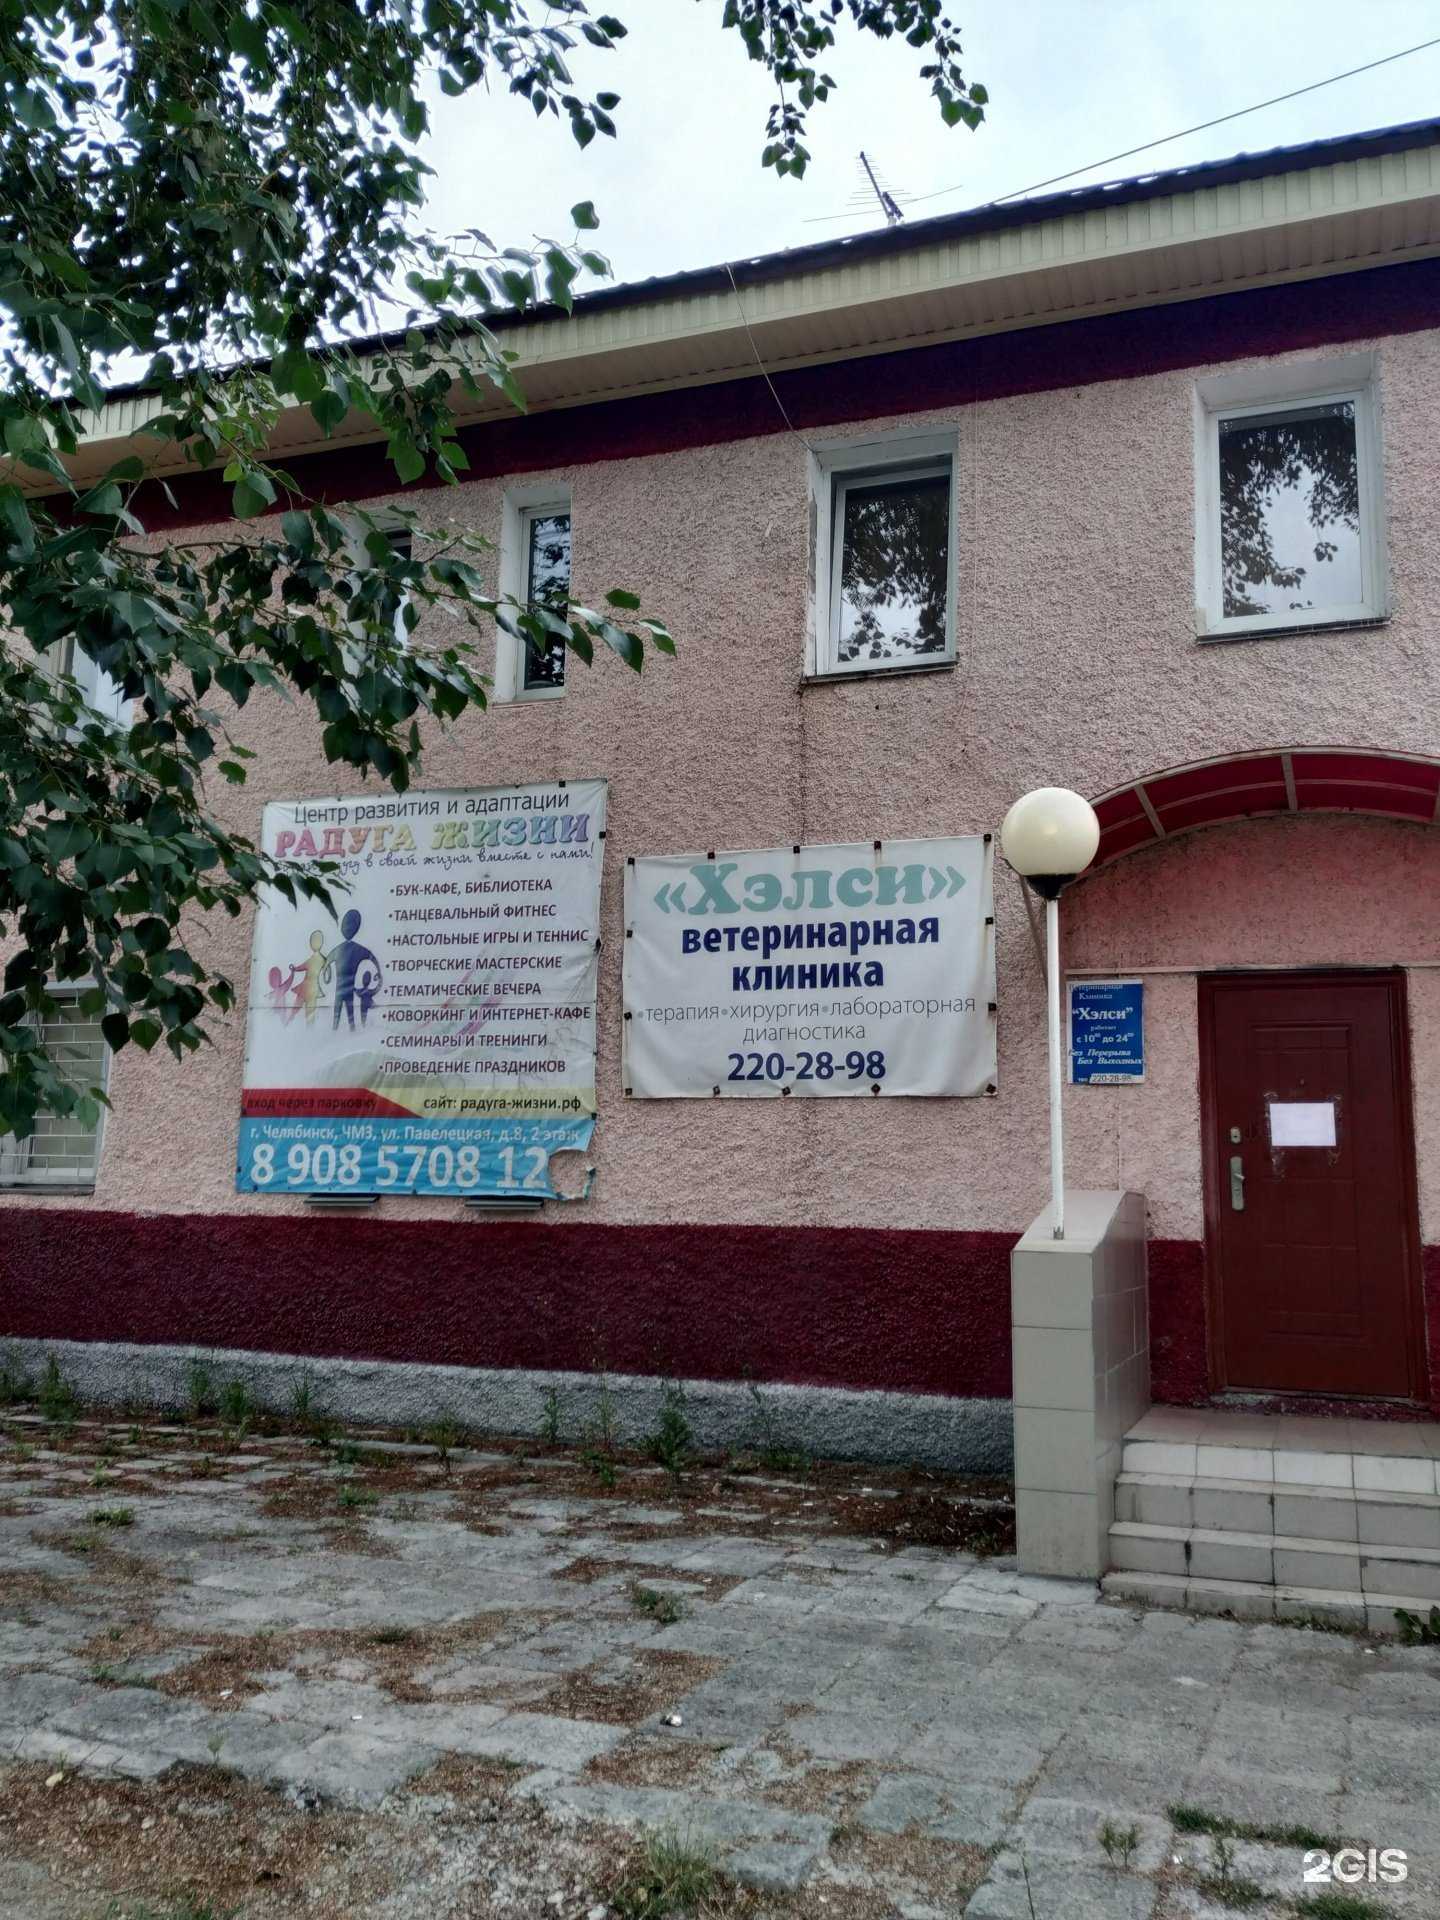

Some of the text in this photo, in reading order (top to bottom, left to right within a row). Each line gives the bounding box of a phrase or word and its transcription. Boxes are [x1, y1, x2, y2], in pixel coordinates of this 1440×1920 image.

[294, 793, 570, 825] Центр развития и адаптации
[274, 812, 591, 860] РАДУГА ЖИЗНИ
[366, 853, 373, 868] в
[379, 850, 418, 867] своей
[423, 854, 473, 870] жизни
[477, 848, 532, 863] вместе
[536, 851, 545, 859] с
[394, 878, 553, 898] БУК-КАФЕ, БИБЛИОТЕКА
[652, 862, 968, 916] «Хэлси»
[394, 904, 557, 923] ТАНЦЕВАЛЬНЫЙ ФИТНЕС
[391, 928, 589, 947] НАСТОЛЬНЫЕ ИГРЫ И ТЕННИС
[681, 917, 940, 959] ветеринарная
[391, 956, 562, 973] ТВОРЧЕСКИЕ МАСТЕРСКИЕ
[731, 960, 885, 992] клиника
[388, 982, 542, 998] ТЕМАТИЧЕСКИЕ ВЕЧЕРА
[386, 1006, 592, 1024] КОВОРКИНГ И ИНТЕРНЕТ-КАФЕ
[644, 995, 976, 1024] терапия хирургия лабораторная
[385, 1033, 548, 1049] СЕМИНАРЫ И ТРЕНИНГИ
[742, 1022, 867, 1046] диагностика
[384, 1059, 566, 1075] ПРОВЕДЕНИЕ ПРАЗДНИКОВ
[727, 1050, 886, 1081] 220-28-98
[423, 1096, 582, 1113] сайт: радуга-жизни.рф
[250, 1124, 580, 1143] г. Челябинск, ЧМЗ, ул. Павелецкая, д.8, 2 этаж
[250, 1143, 547, 1190] 8 908 5708 12
